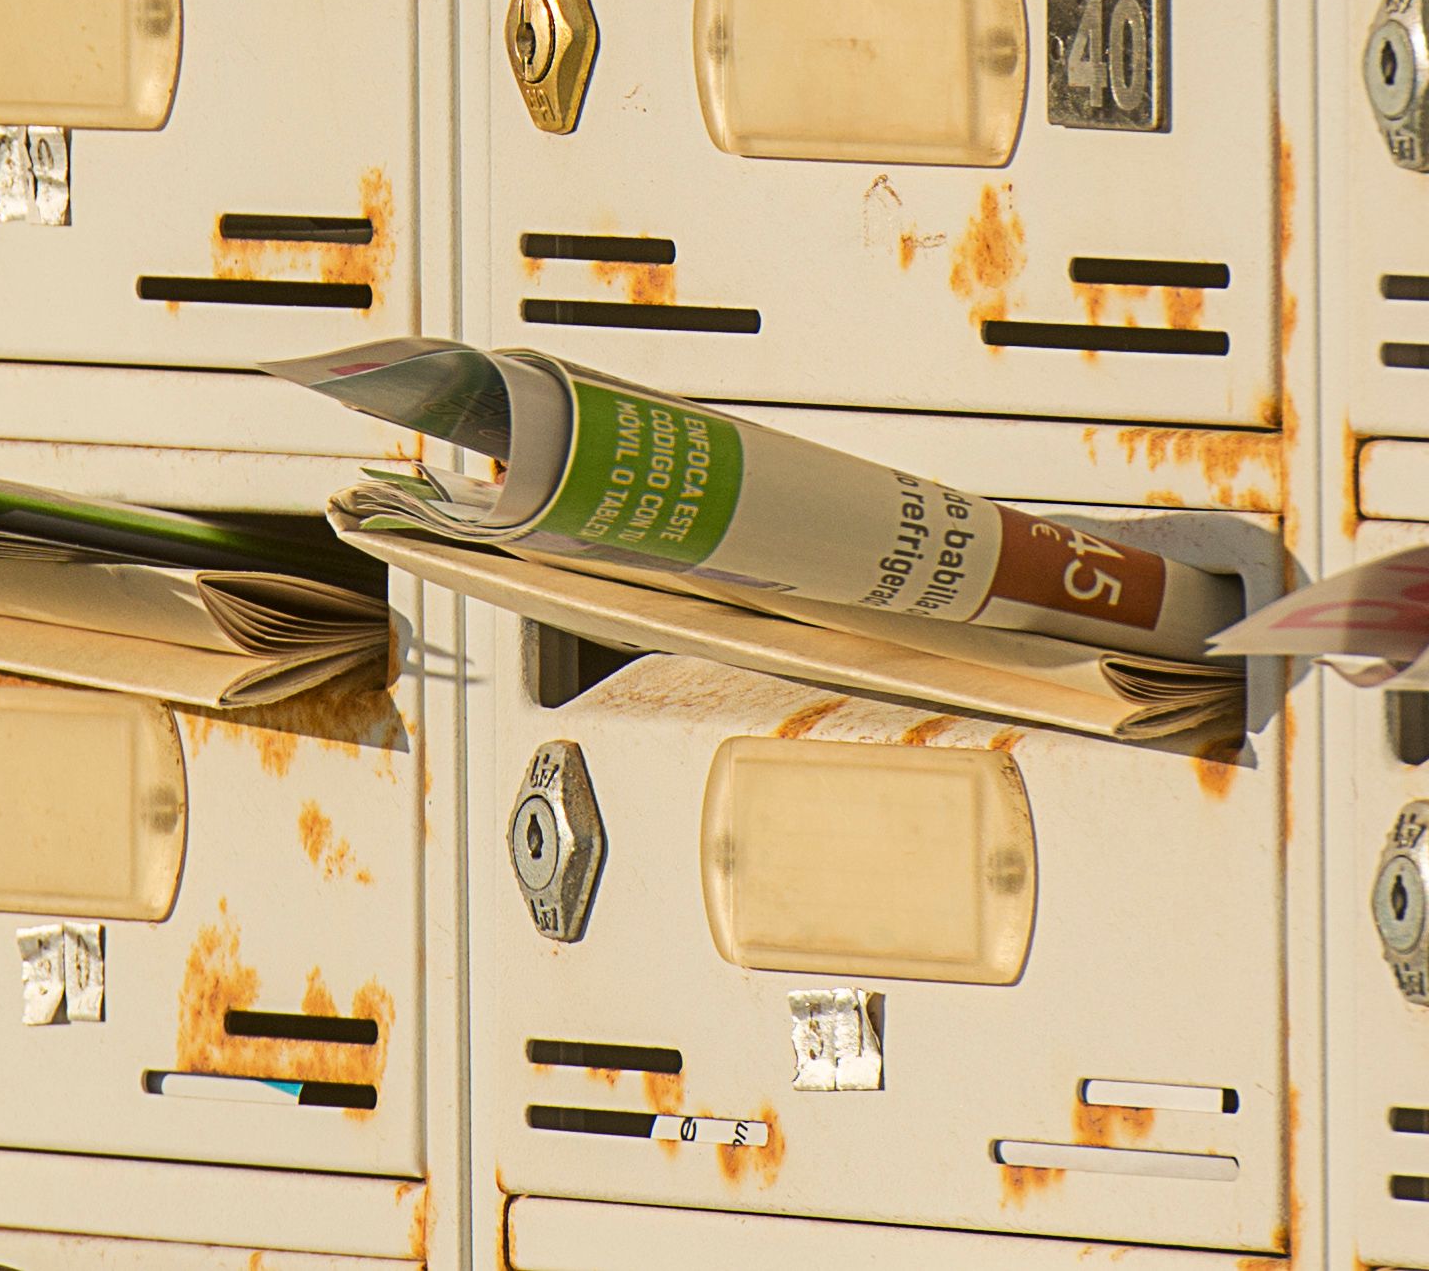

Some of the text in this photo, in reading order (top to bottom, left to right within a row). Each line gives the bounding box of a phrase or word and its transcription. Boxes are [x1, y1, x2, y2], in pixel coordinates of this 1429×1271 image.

[614, 400, 646, 463] MÓVIL
[647, 408, 679, 490] CÓDIGO
[628, 493, 664, 530] CON
[660, 416, 711, 543] ENFOCA ESTE
[924, 527, 975, 610] babilla
